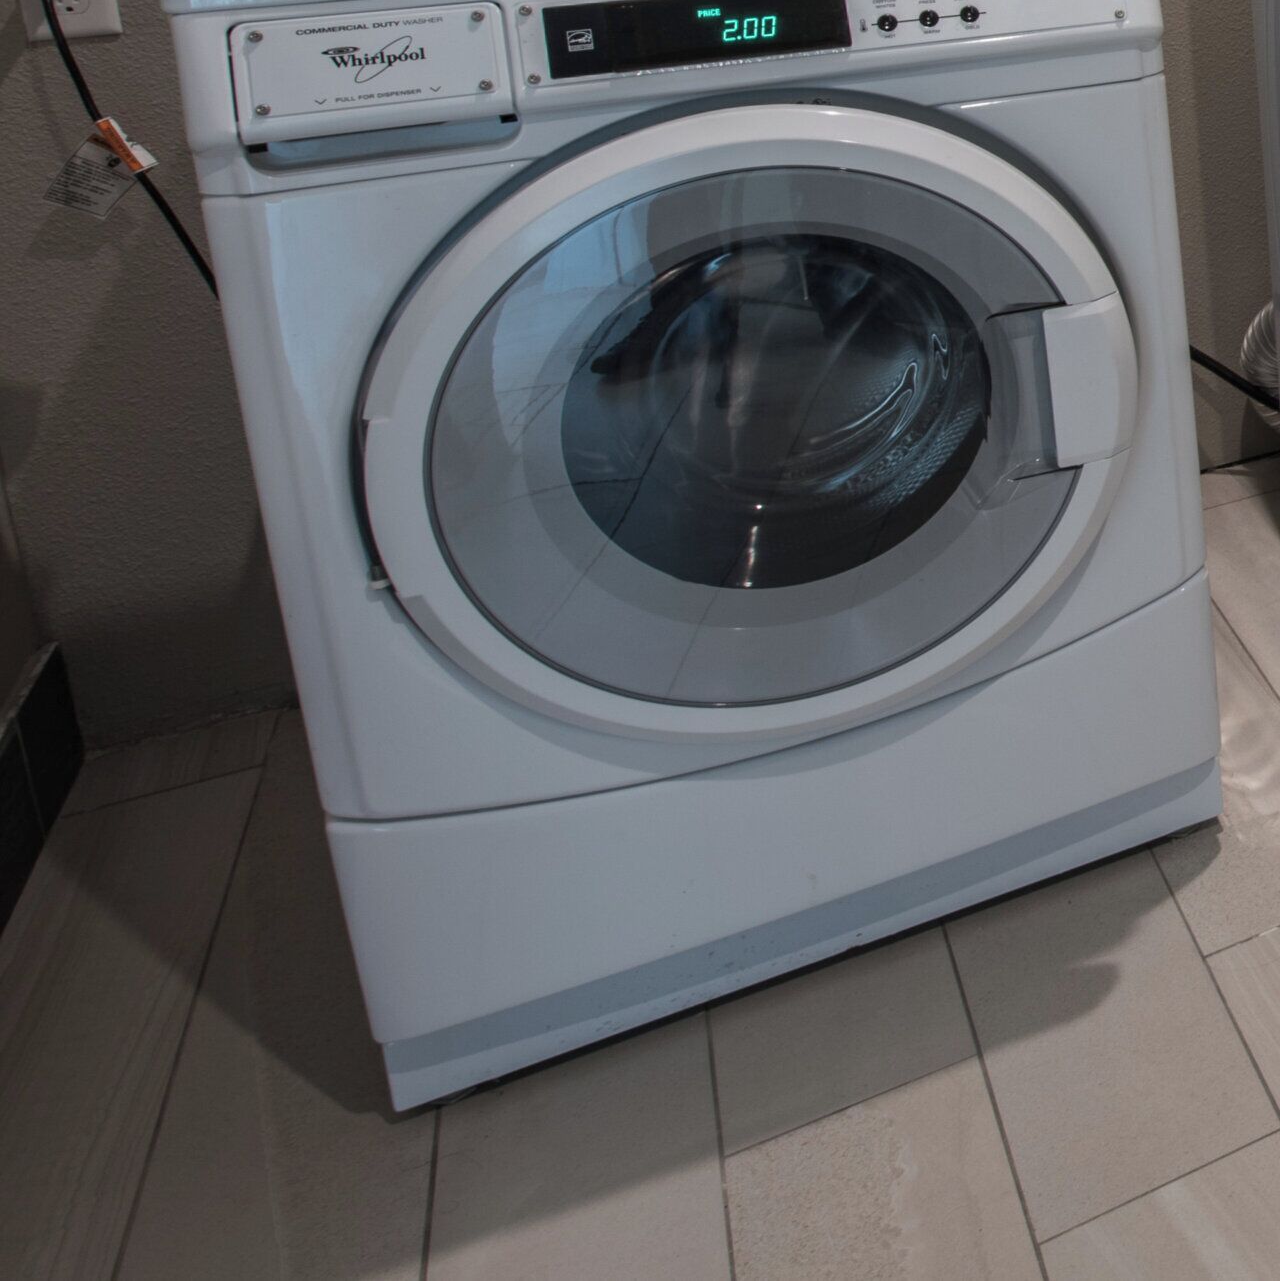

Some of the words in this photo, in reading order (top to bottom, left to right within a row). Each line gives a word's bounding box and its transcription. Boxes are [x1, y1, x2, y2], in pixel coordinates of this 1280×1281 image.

[697, 7, 721, 18] PRICE
[296, 23, 369, 36] COMMERCIAL
[372, 21, 400, 29] DUTY
[402, 17, 444, 26] WASHER
[722, 15, 777, 42] 2.00
[330, 47, 426, 68] Whirlpool
[335, 95, 356, 103] PULL
[358, 93, 375, 101] FOR
[377, 88, 422, 99] DISPENSER
